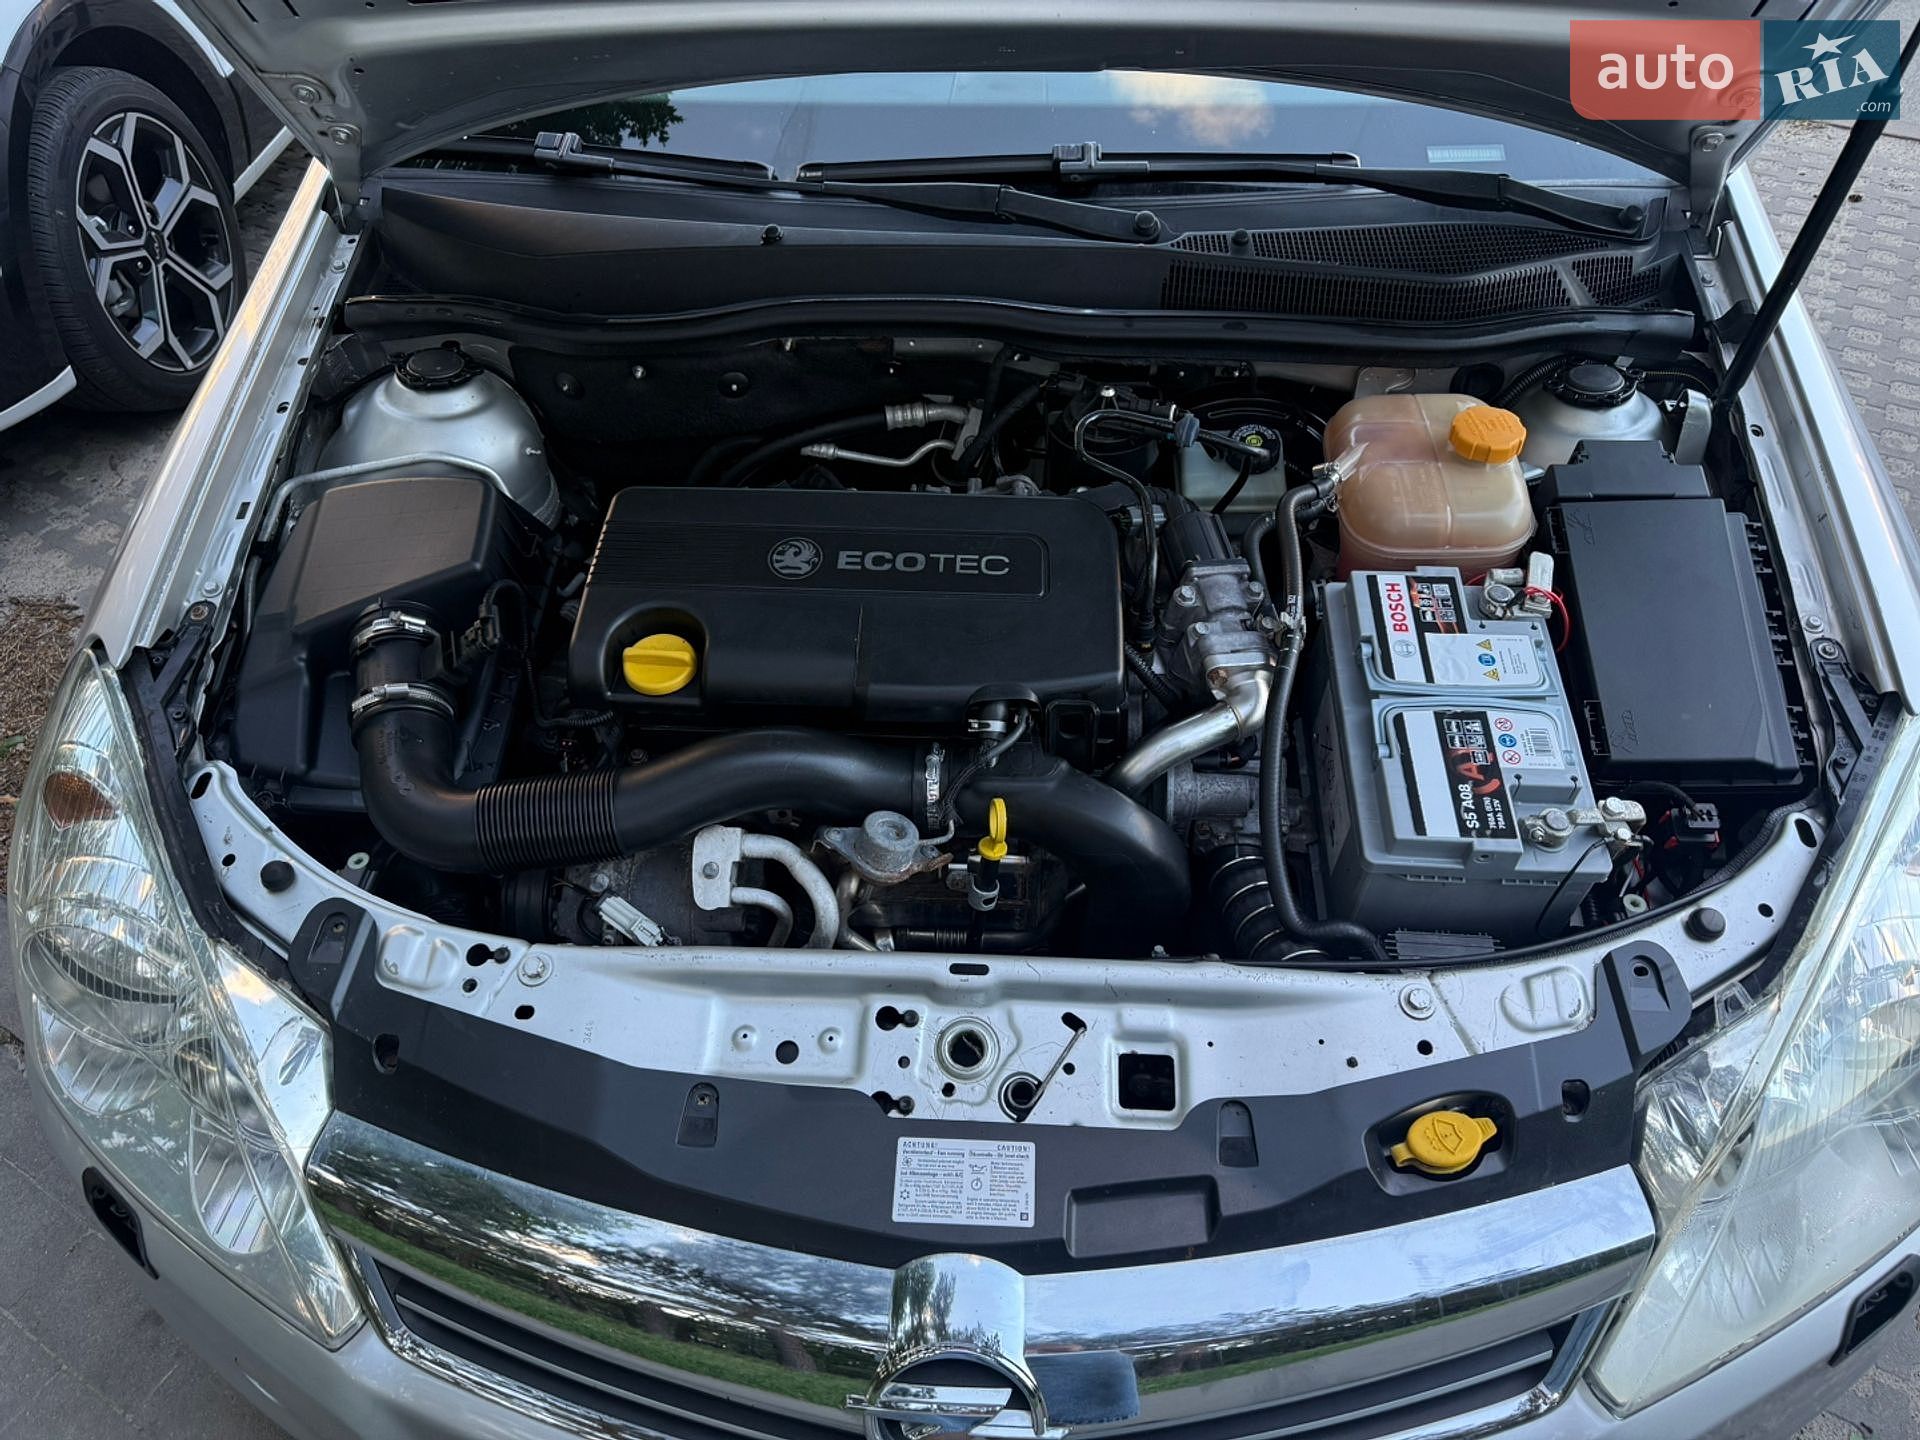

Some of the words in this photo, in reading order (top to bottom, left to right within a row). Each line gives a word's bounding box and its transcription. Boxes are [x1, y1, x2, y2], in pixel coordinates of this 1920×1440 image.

[836, 550, 1010, 575] ECOTEC
[1385, 582, 1409, 632] BOSCH
[1458, 784, 1475, 809] A08
[1466, 812, 1480, 828] S5
